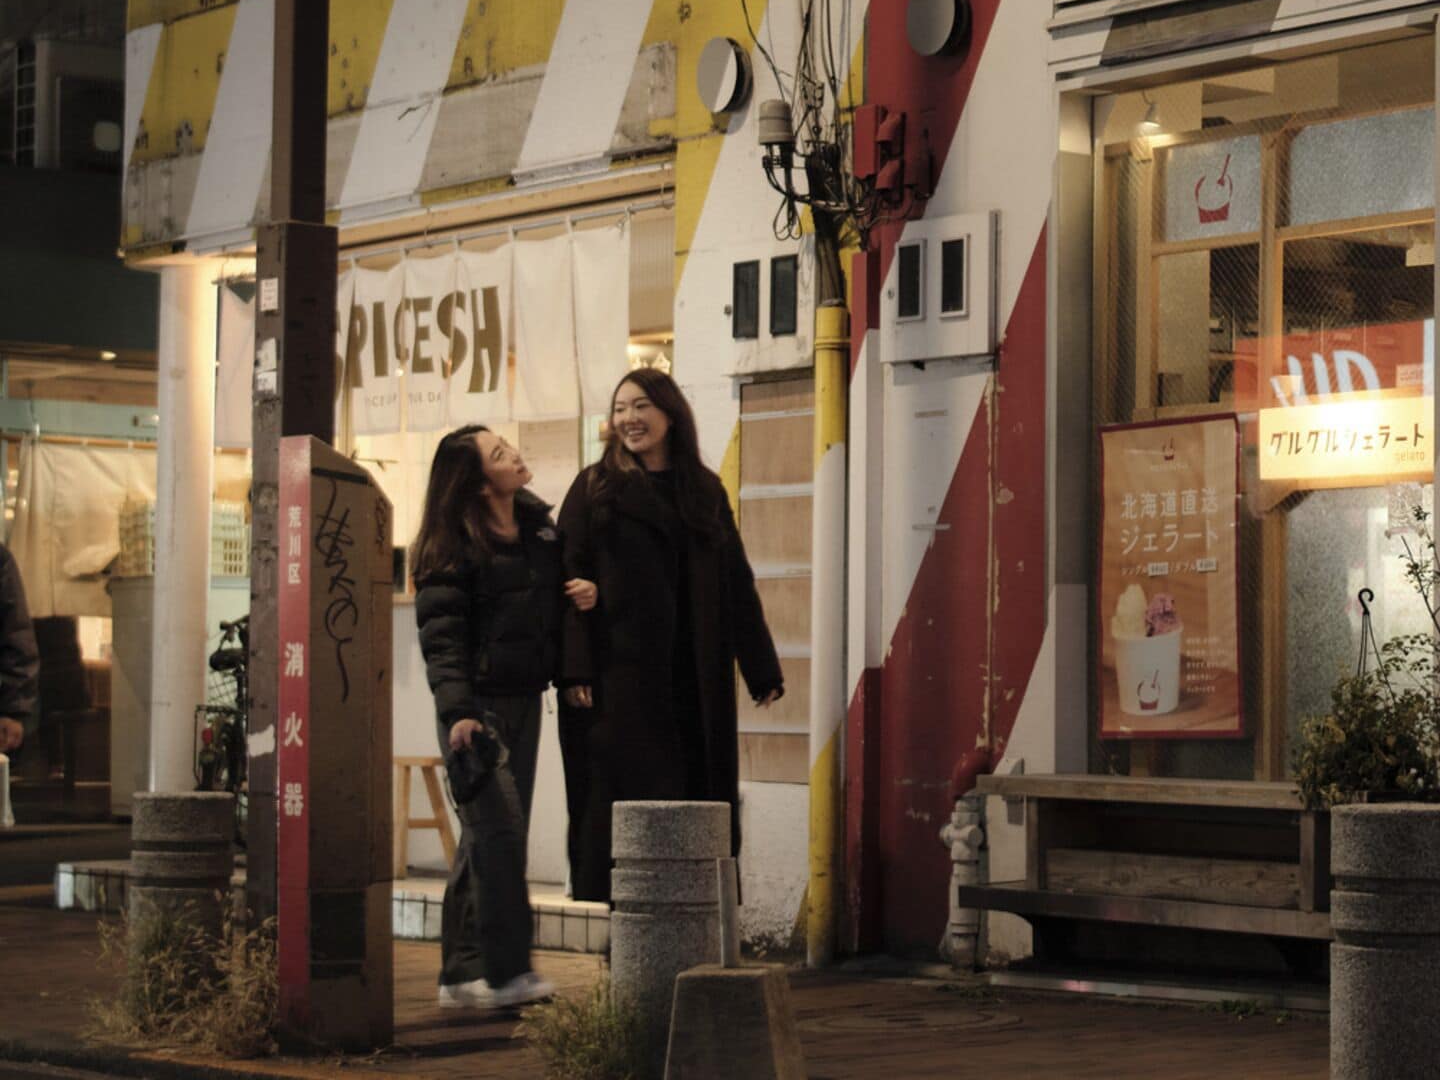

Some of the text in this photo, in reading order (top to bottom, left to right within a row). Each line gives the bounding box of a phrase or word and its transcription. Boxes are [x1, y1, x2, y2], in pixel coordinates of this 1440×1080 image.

[336, 285, 502, 402] PICESH
[1120, 520, 1219, 556] ジェラート
[1121, 487, 1219, 520] 北海道直送
[283, 505, 304, 817] 荒川区 消火器
